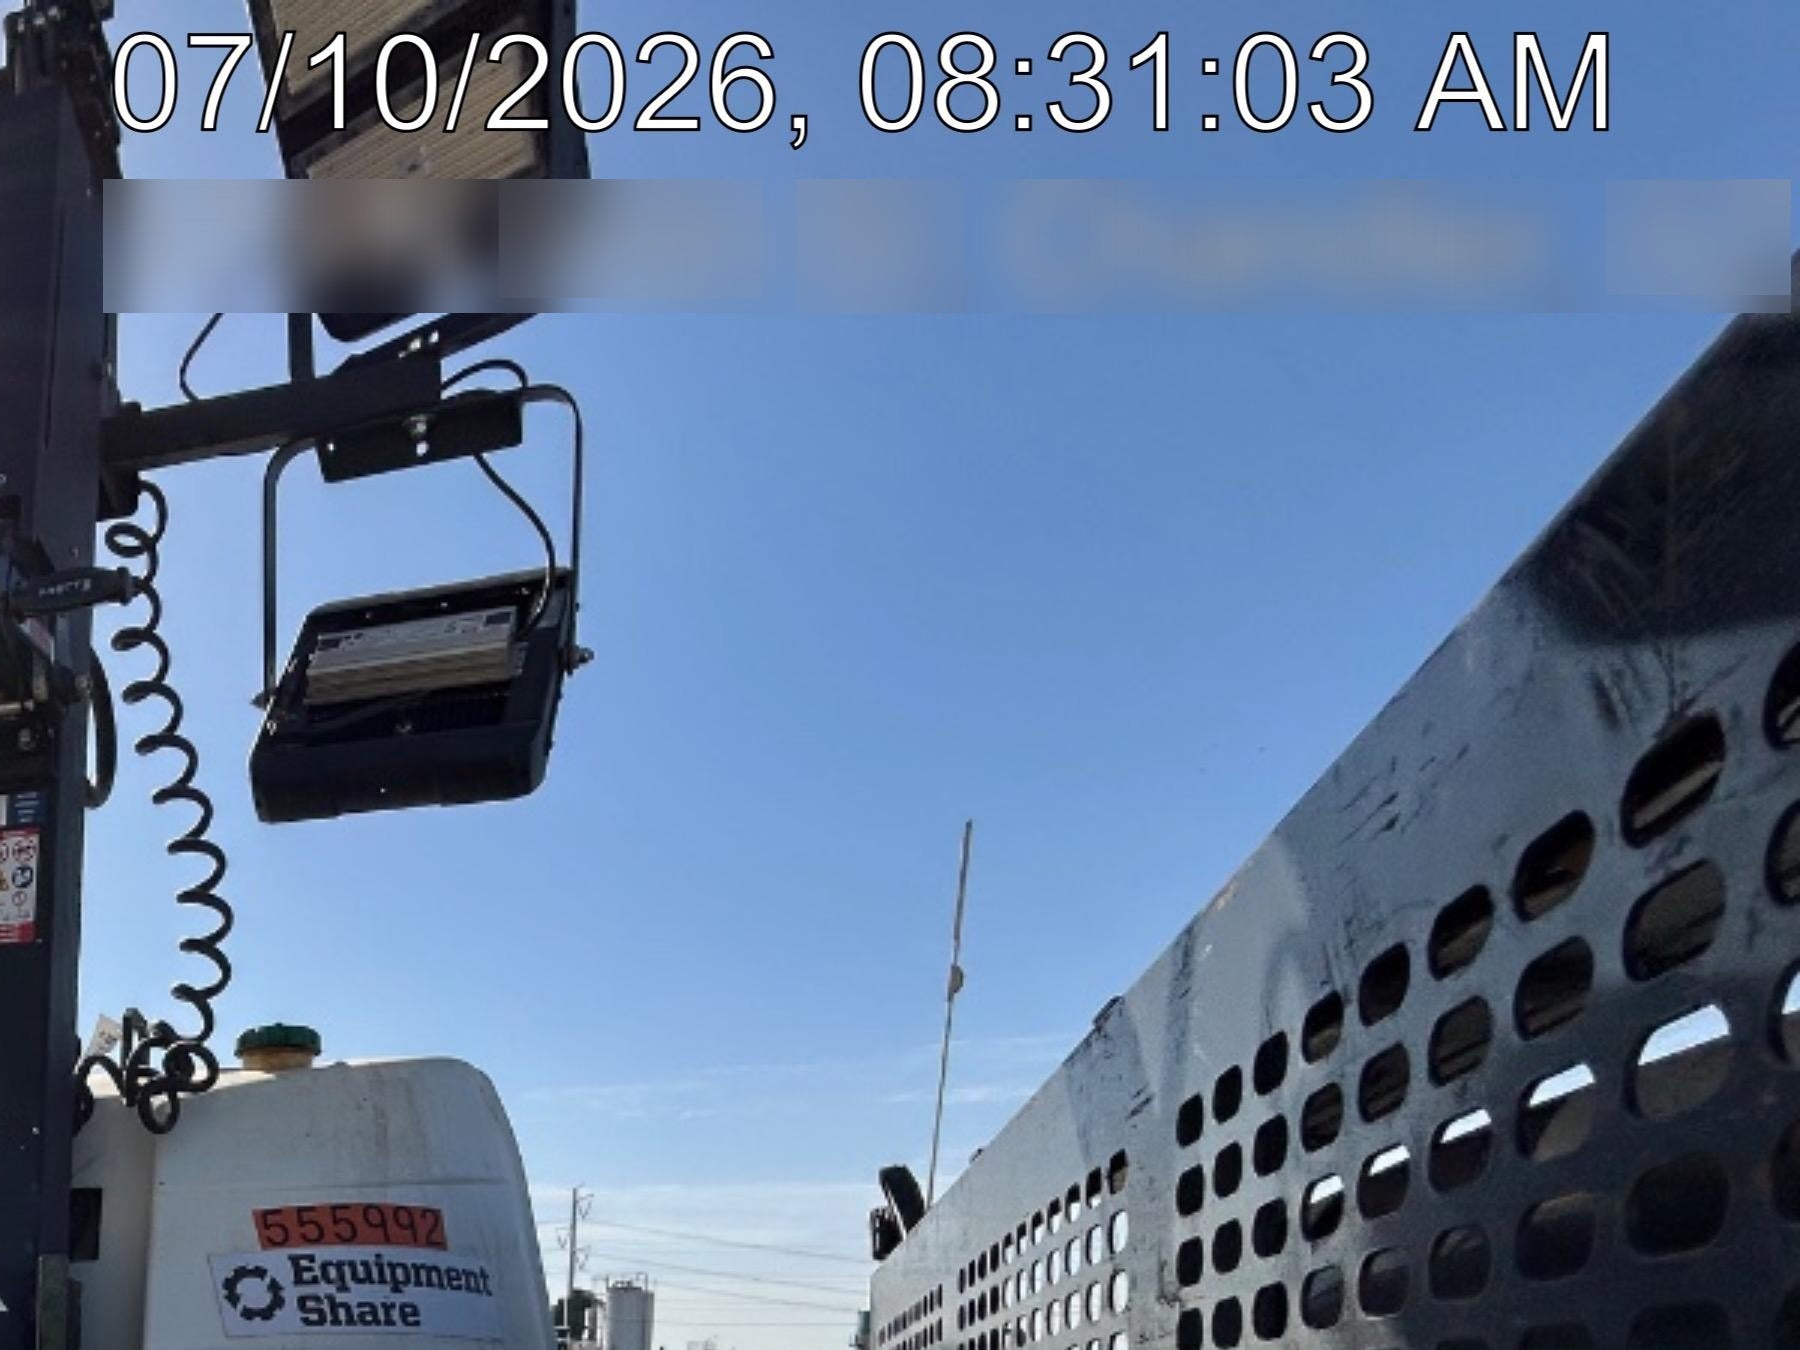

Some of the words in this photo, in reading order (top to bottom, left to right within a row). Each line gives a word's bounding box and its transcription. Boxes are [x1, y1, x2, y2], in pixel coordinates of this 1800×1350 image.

[262, 1206, 442, 1247] 555992
[288, 1253, 492, 1296] Equipment
[296, 1293, 421, 1327] Share
